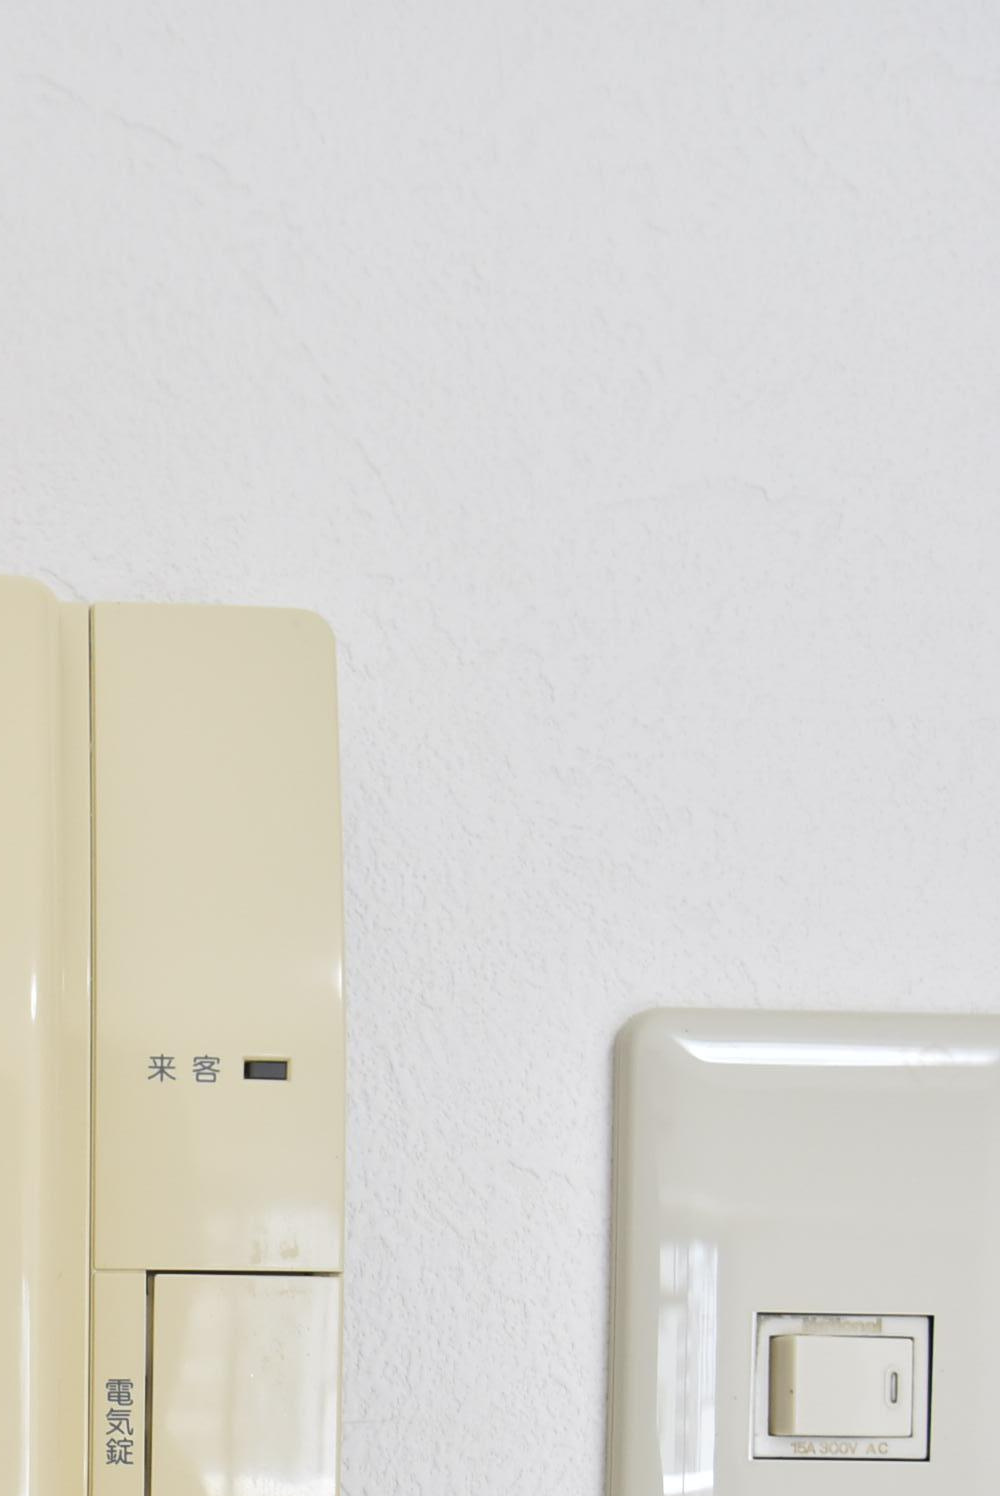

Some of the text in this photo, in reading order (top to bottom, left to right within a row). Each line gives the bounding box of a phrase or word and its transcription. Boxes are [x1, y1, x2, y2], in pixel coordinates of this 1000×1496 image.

[147, 1054, 220, 1083] 来客
[105, 1378, 134, 1466] 電気錠
